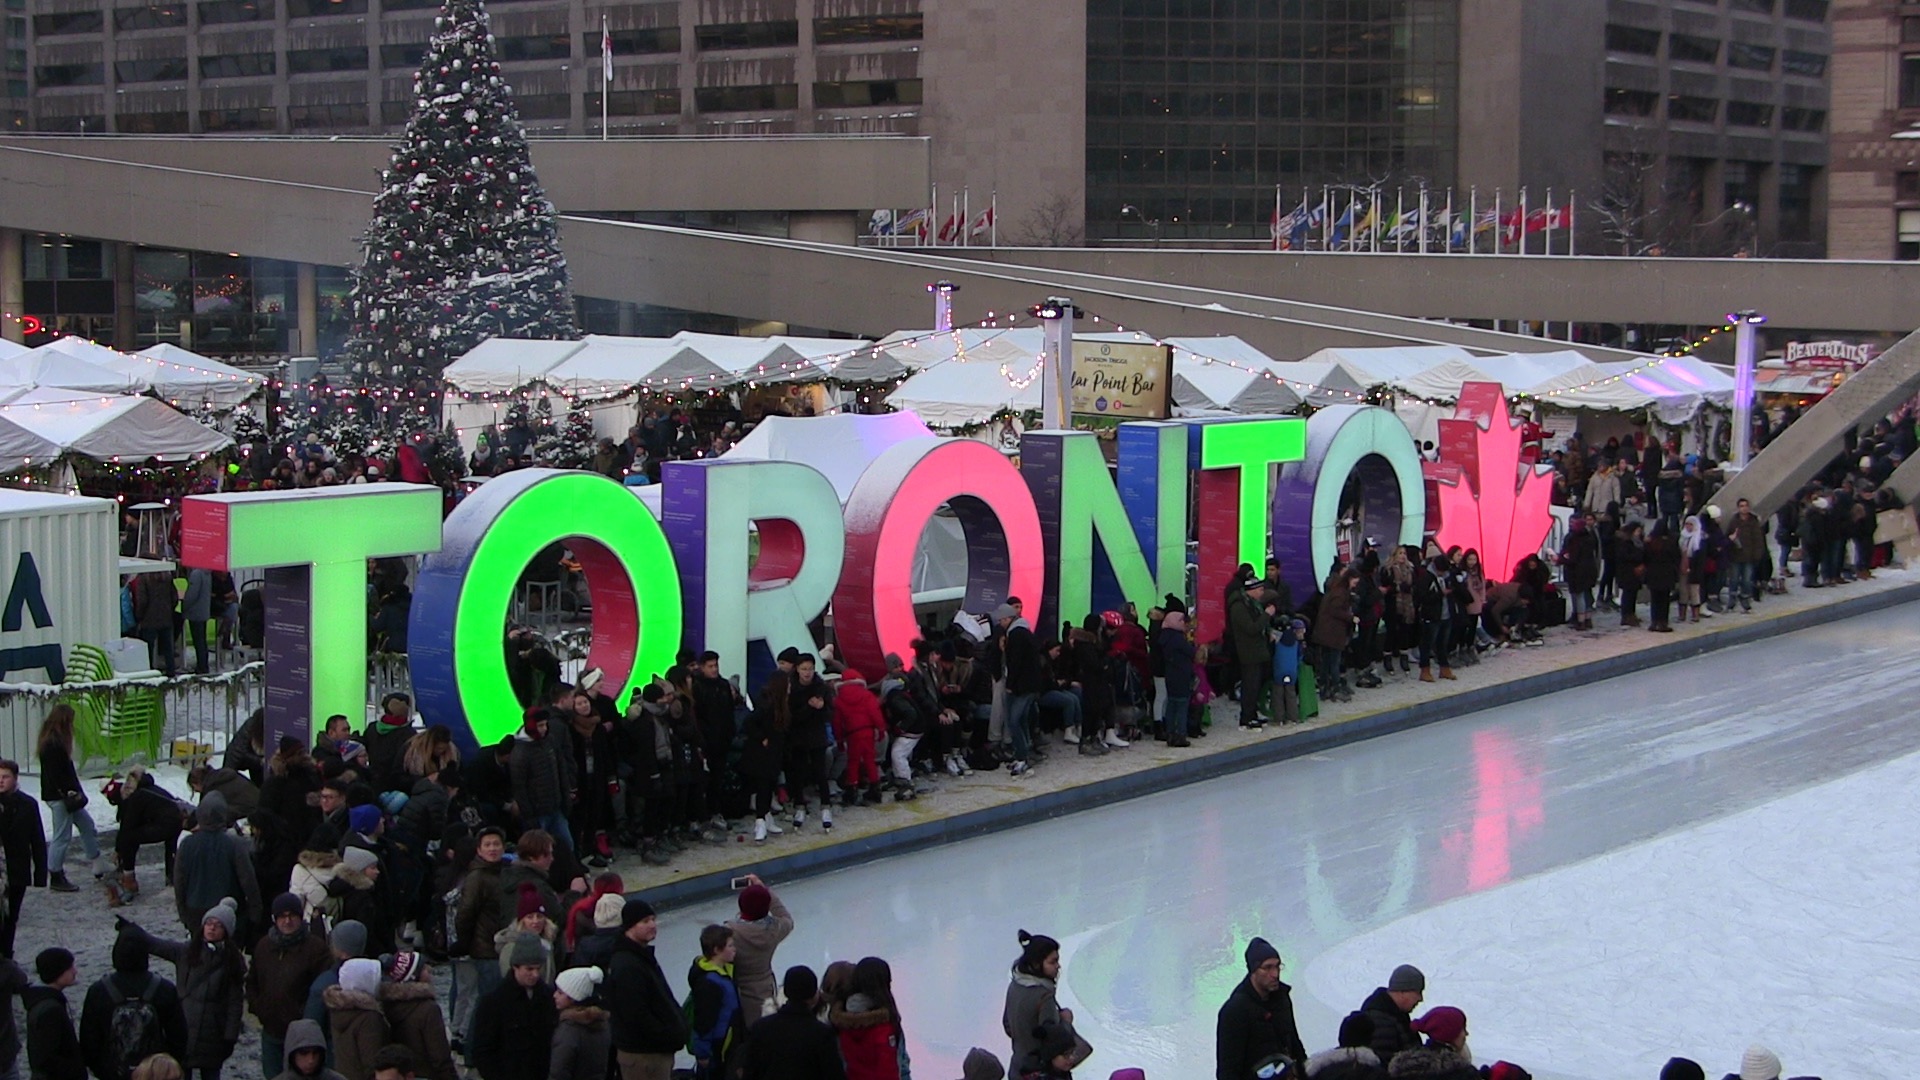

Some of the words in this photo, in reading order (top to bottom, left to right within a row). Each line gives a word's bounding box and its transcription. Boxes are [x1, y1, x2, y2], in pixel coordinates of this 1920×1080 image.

[1786, 340, 1868, 365] BEAVERTAILS
[1093, 370, 1129, 393] Point
[1132, 372, 1155, 396] Bar
[183, 404, 1427, 748] TORONTO
